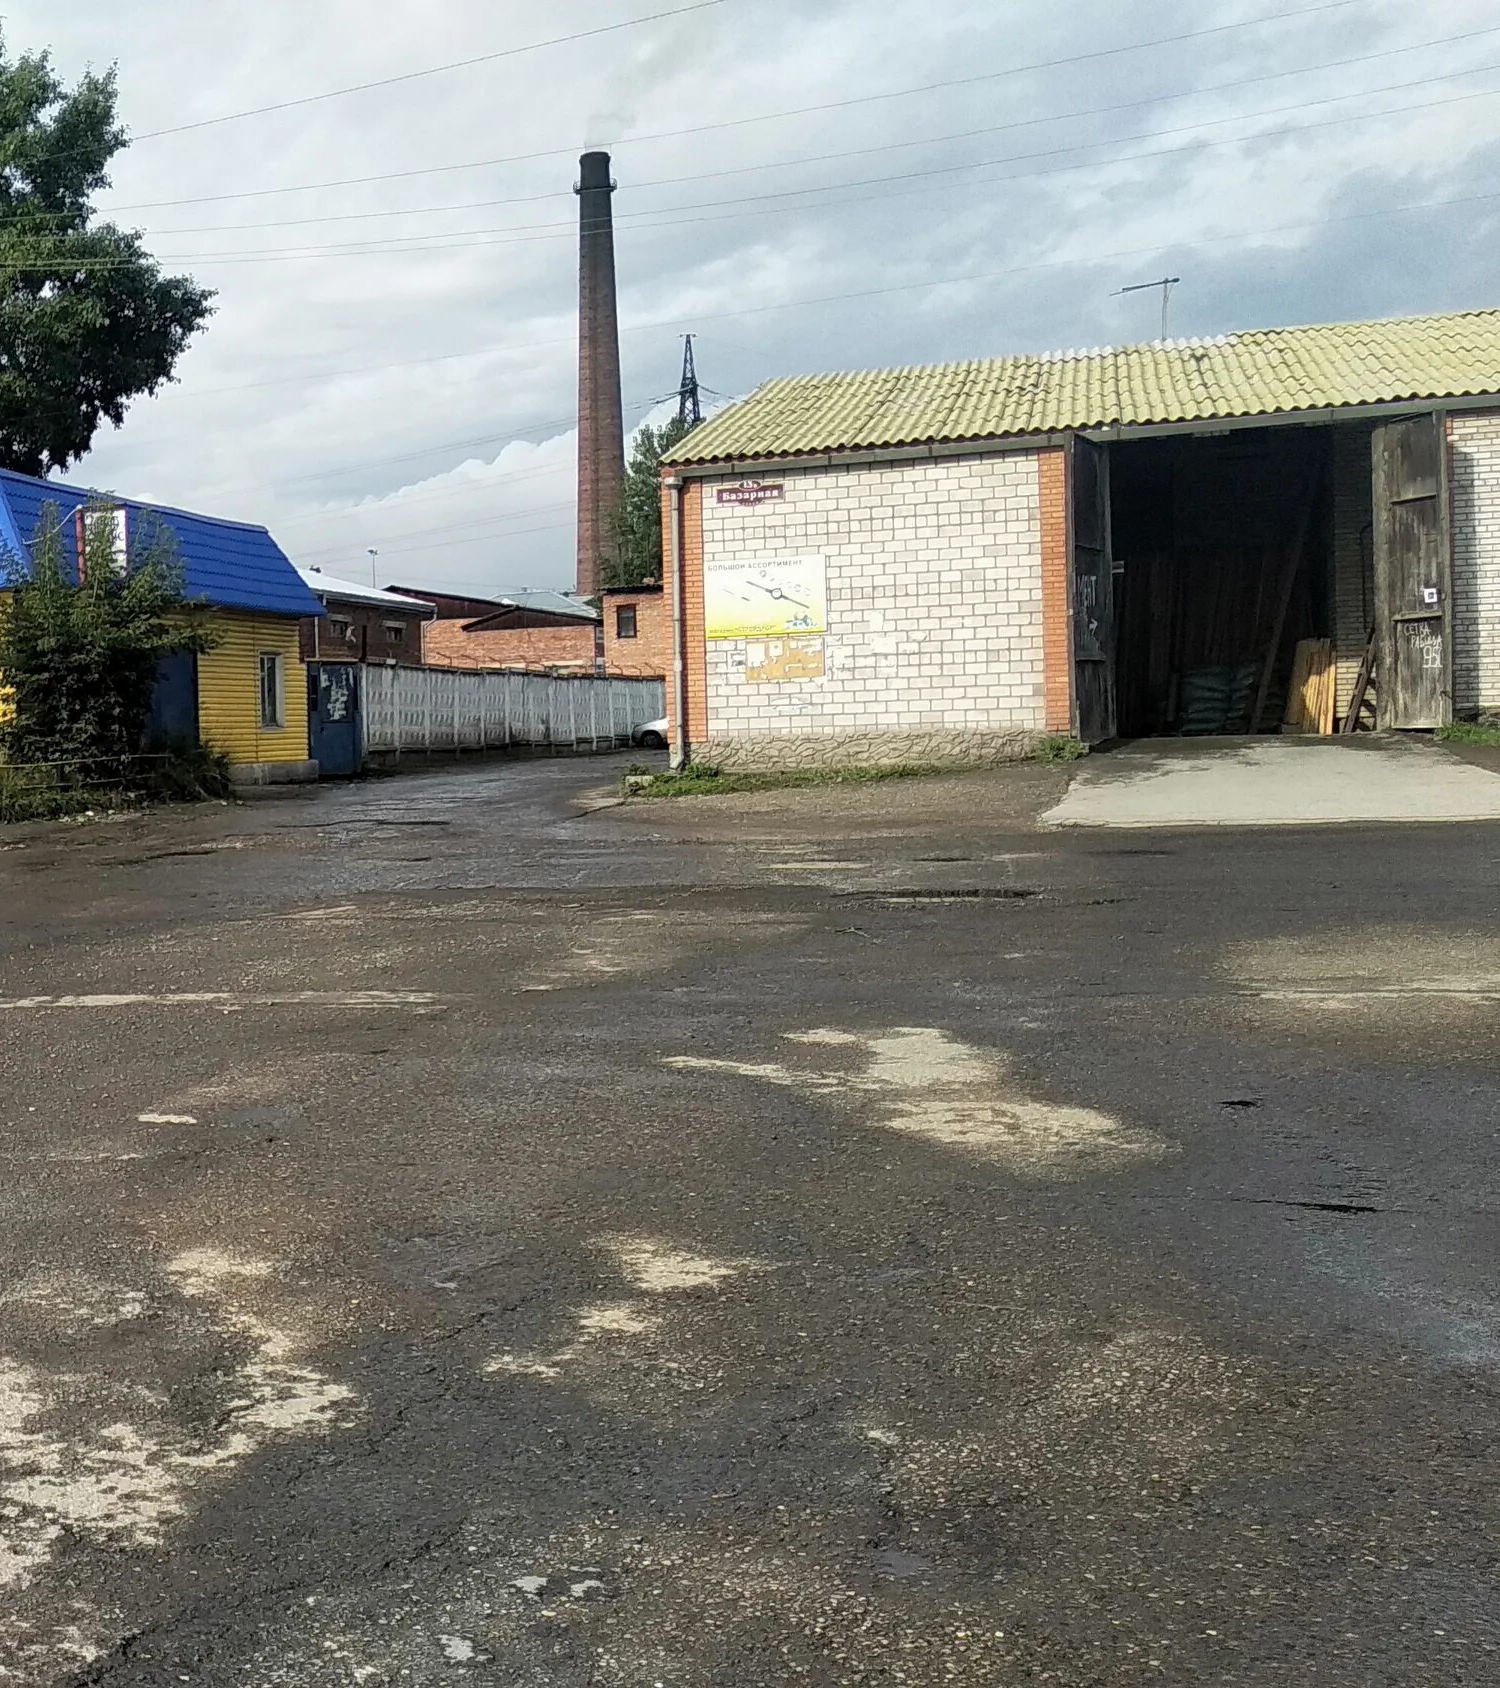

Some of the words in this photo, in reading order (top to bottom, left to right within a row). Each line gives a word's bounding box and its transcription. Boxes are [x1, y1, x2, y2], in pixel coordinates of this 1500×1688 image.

[722, 489, 779, 500] Базарная
[707, 563, 746, 571] БОЛЬШОЙ
[748, 560, 803, 569] АССОРТИМЕНТ
[1404, 622, 1431, 636] СЕТКА
